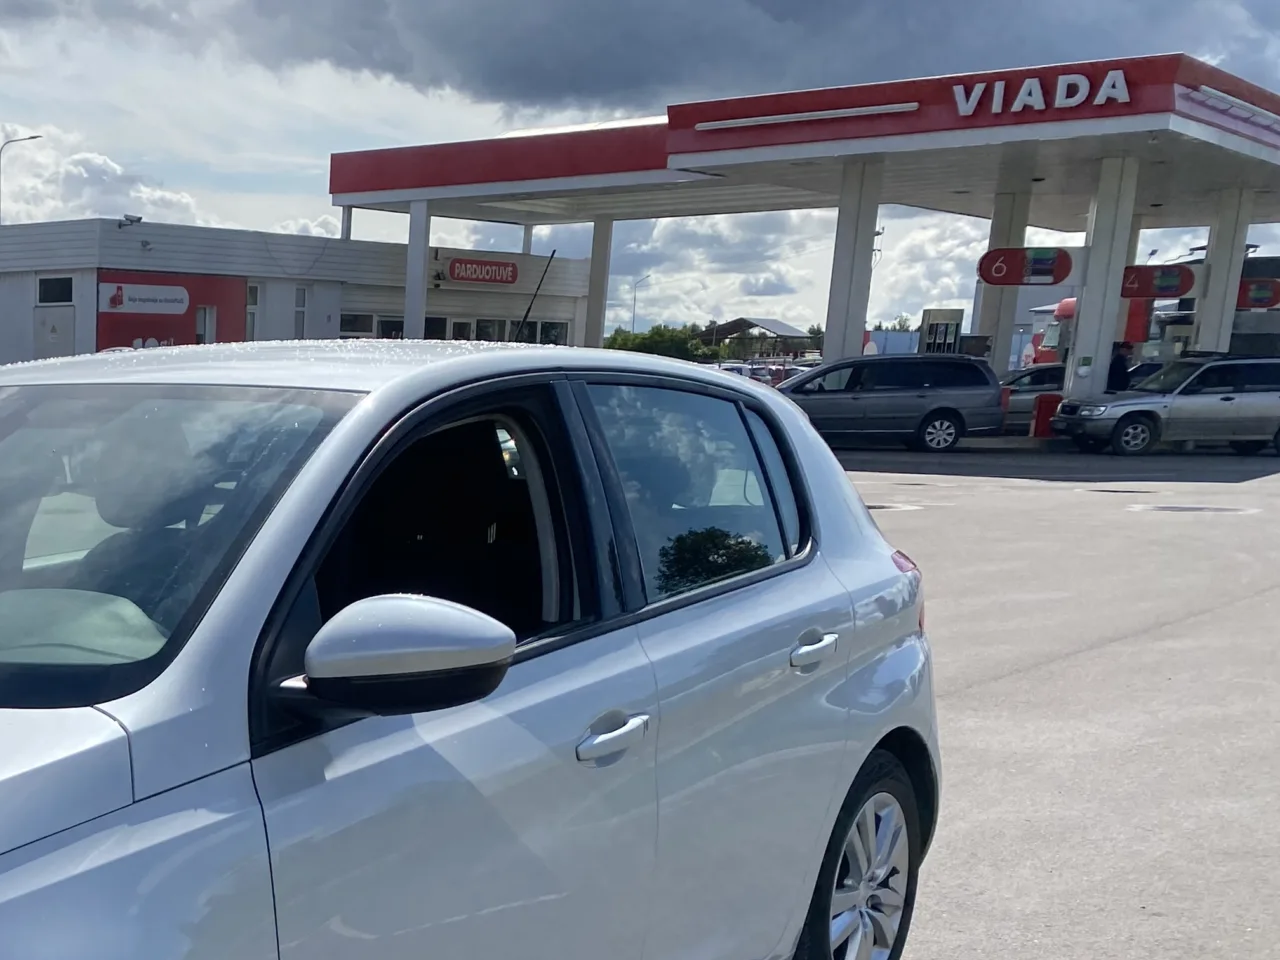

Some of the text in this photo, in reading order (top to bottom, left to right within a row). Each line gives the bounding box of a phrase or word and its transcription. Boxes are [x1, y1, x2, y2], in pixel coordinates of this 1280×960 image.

[952, 69, 1131, 117] VIADA
[454, 262, 514, 281] PARDUOTUVĖ
[991, 256, 1007, 277] 6
[1125, 273, 1139, 291] 4
